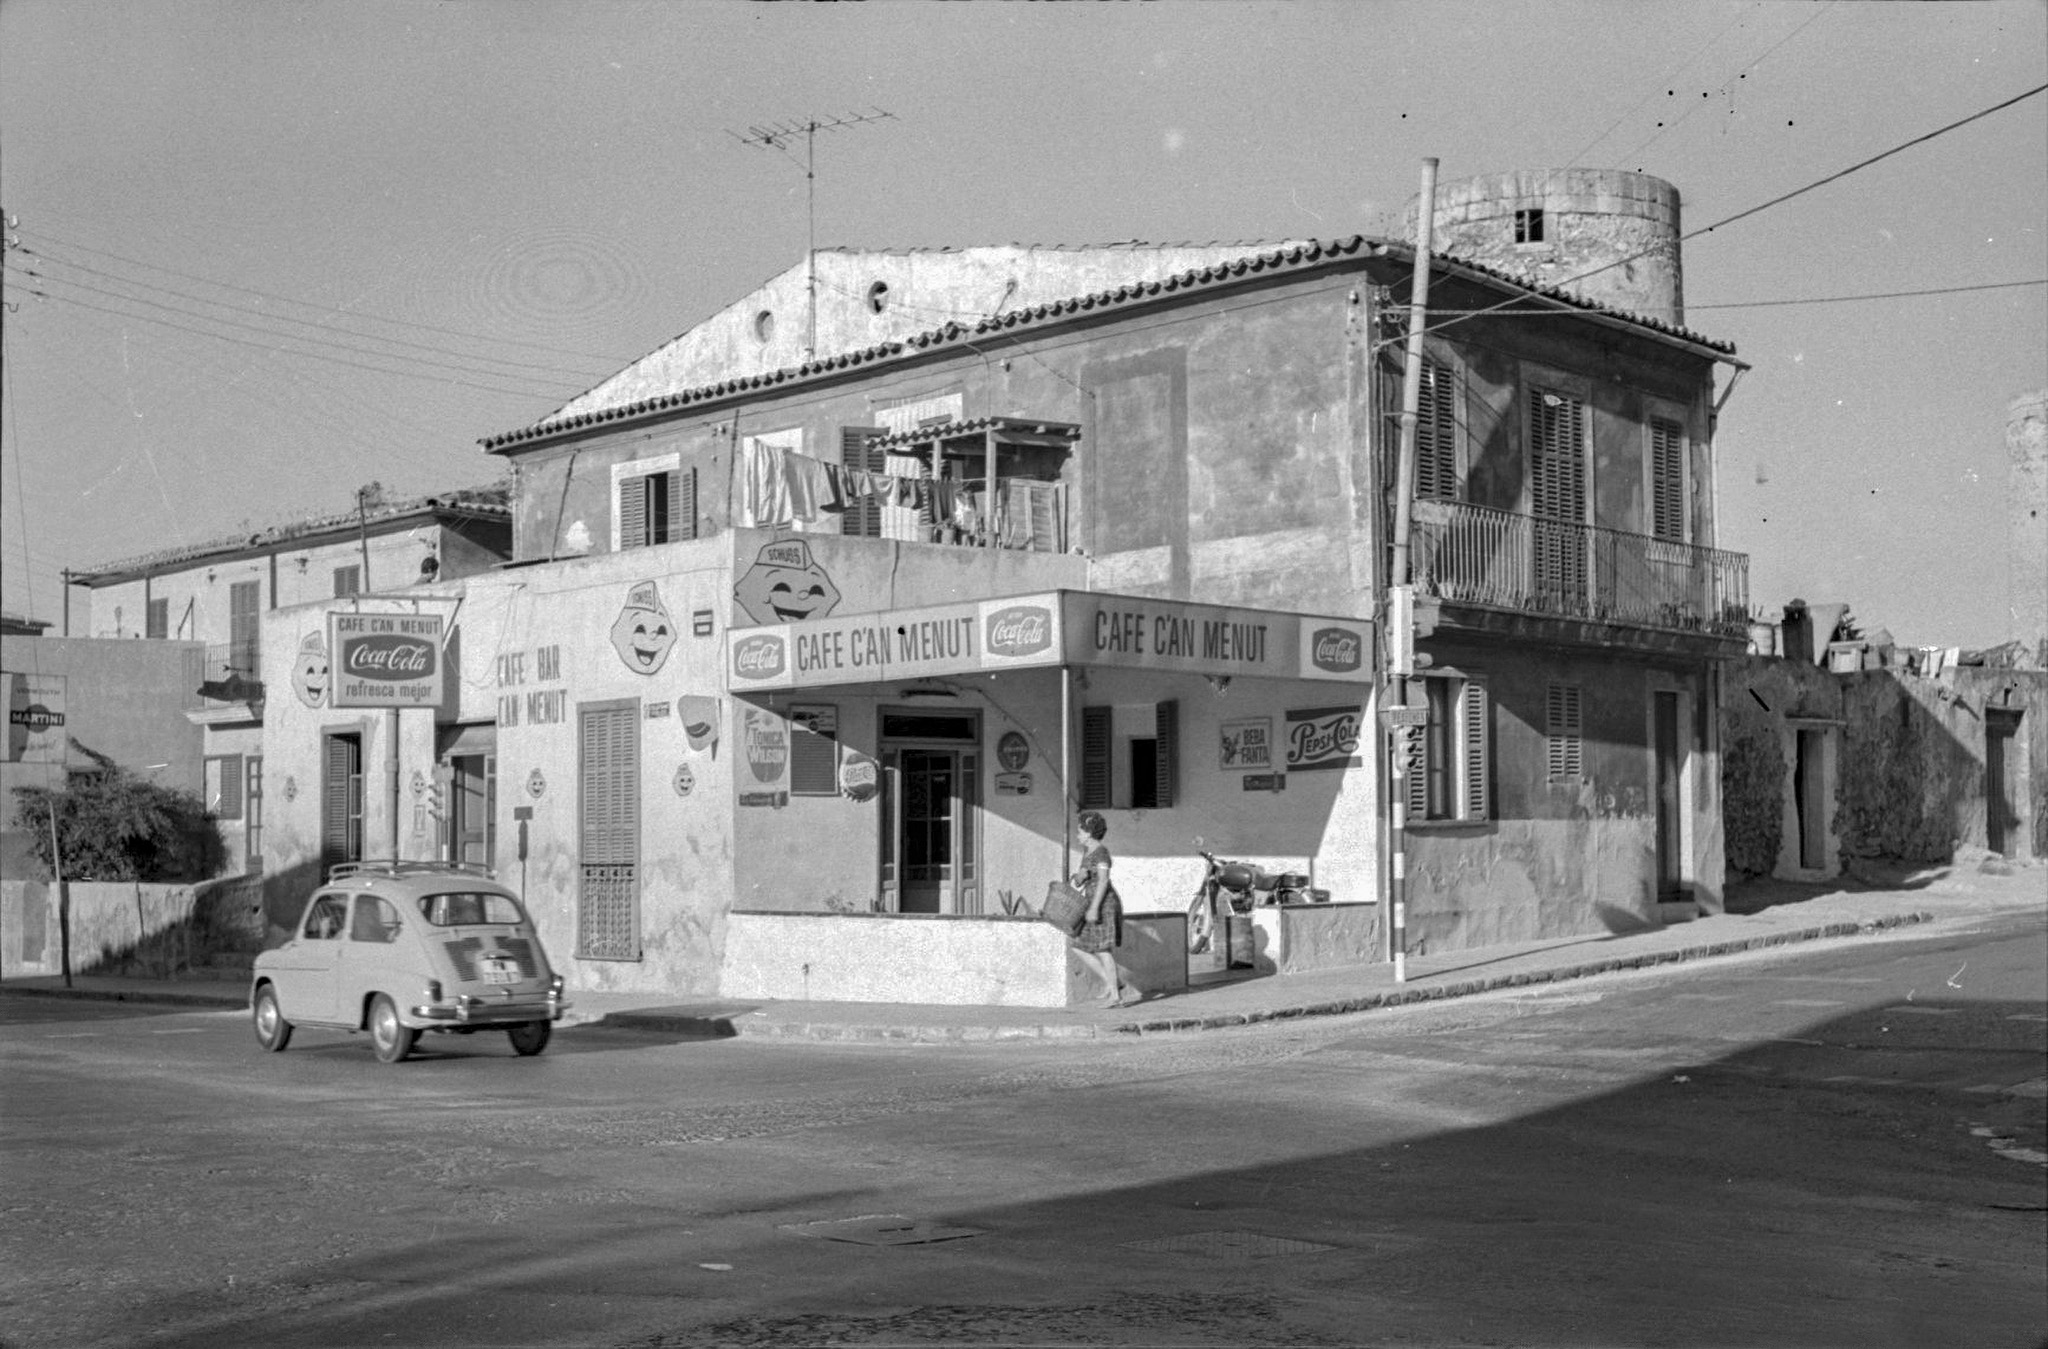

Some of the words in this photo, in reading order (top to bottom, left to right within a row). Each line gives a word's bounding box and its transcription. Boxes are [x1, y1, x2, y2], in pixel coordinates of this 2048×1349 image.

[338, 617, 365, 632] CAFE
[400, 618, 439, 634] MENUT
[1095, 610, 1145, 654] CAFE
[1154, 614, 1195, 657] C'AN
[1203, 620, 1267, 662] MENUT
[350, 643, 430, 671] Coca-Cola
[797, 631, 844, 671] CAFE
[851, 626, 892, 666] C'AN
[899, 617, 973, 662] MENUT
[497, 651, 525, 688] CAFE
[537, 644, 561, 682] BAR
[346, 680, 395, 698] refresca
[399, 683, 433, 702] mejor
[11, 712, 63, 725] MARTINI
[527, 688, 567, 726] MENUT
[1241, 745, 1270, 765] FANTA
